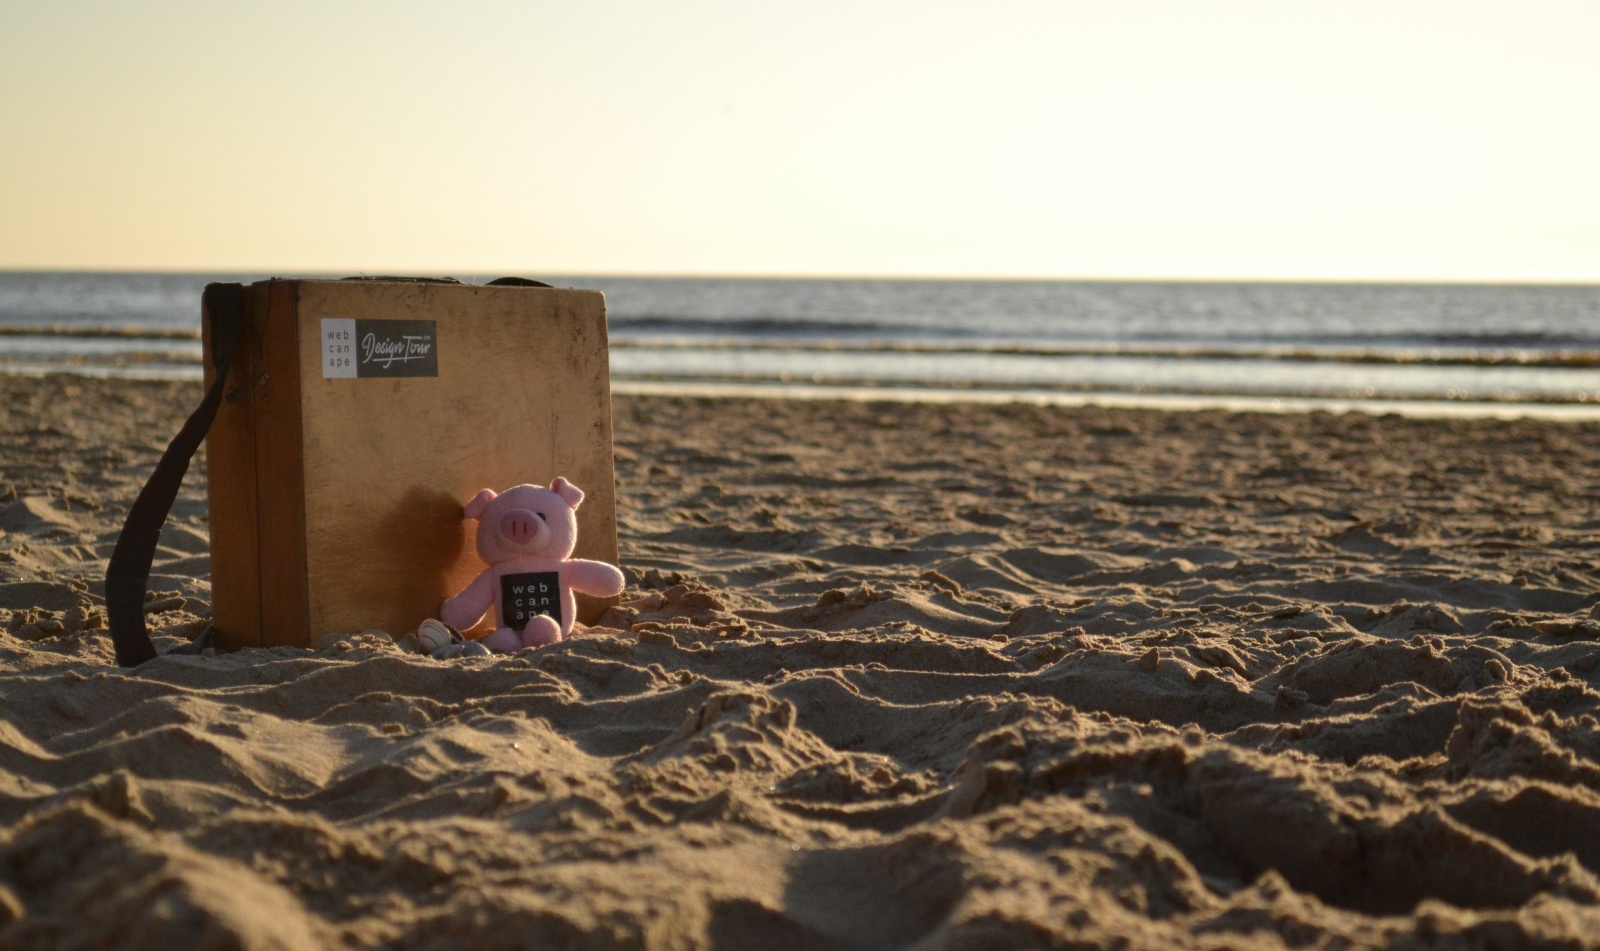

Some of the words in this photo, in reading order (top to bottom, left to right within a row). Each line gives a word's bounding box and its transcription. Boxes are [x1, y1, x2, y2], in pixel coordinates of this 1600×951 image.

[327, 329, 349, 340] web
[328, 344, 349, 353] can
[361, 333, 405, 369] Design
[402, 335, 431, 363] Tour
[329, 358, 350, 368] ape
[512, 582, 548, 594] web
[515, 597, 549, 607] can
